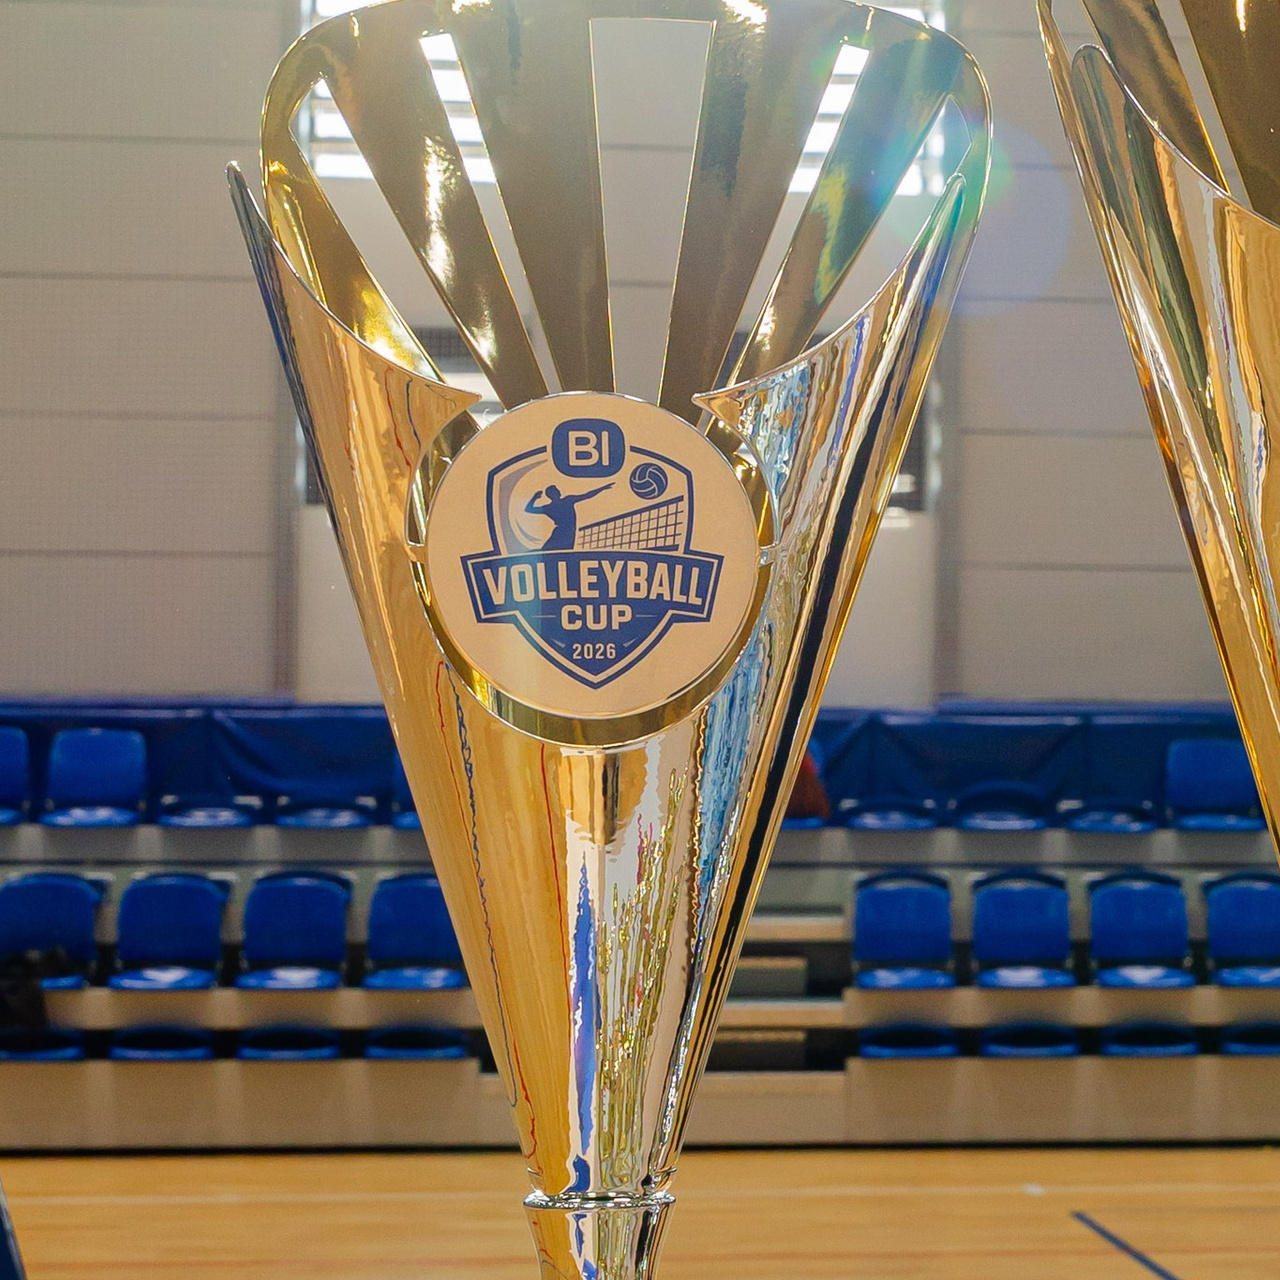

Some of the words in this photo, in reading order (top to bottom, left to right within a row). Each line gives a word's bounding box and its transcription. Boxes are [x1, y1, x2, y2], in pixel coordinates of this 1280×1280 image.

[567, 430, 610, 467] BI
[482, 559, 703, 607] VOLLEYBALL
[560, 604, 634, 630] CUP
[572, 643, 616, 659] 2026
